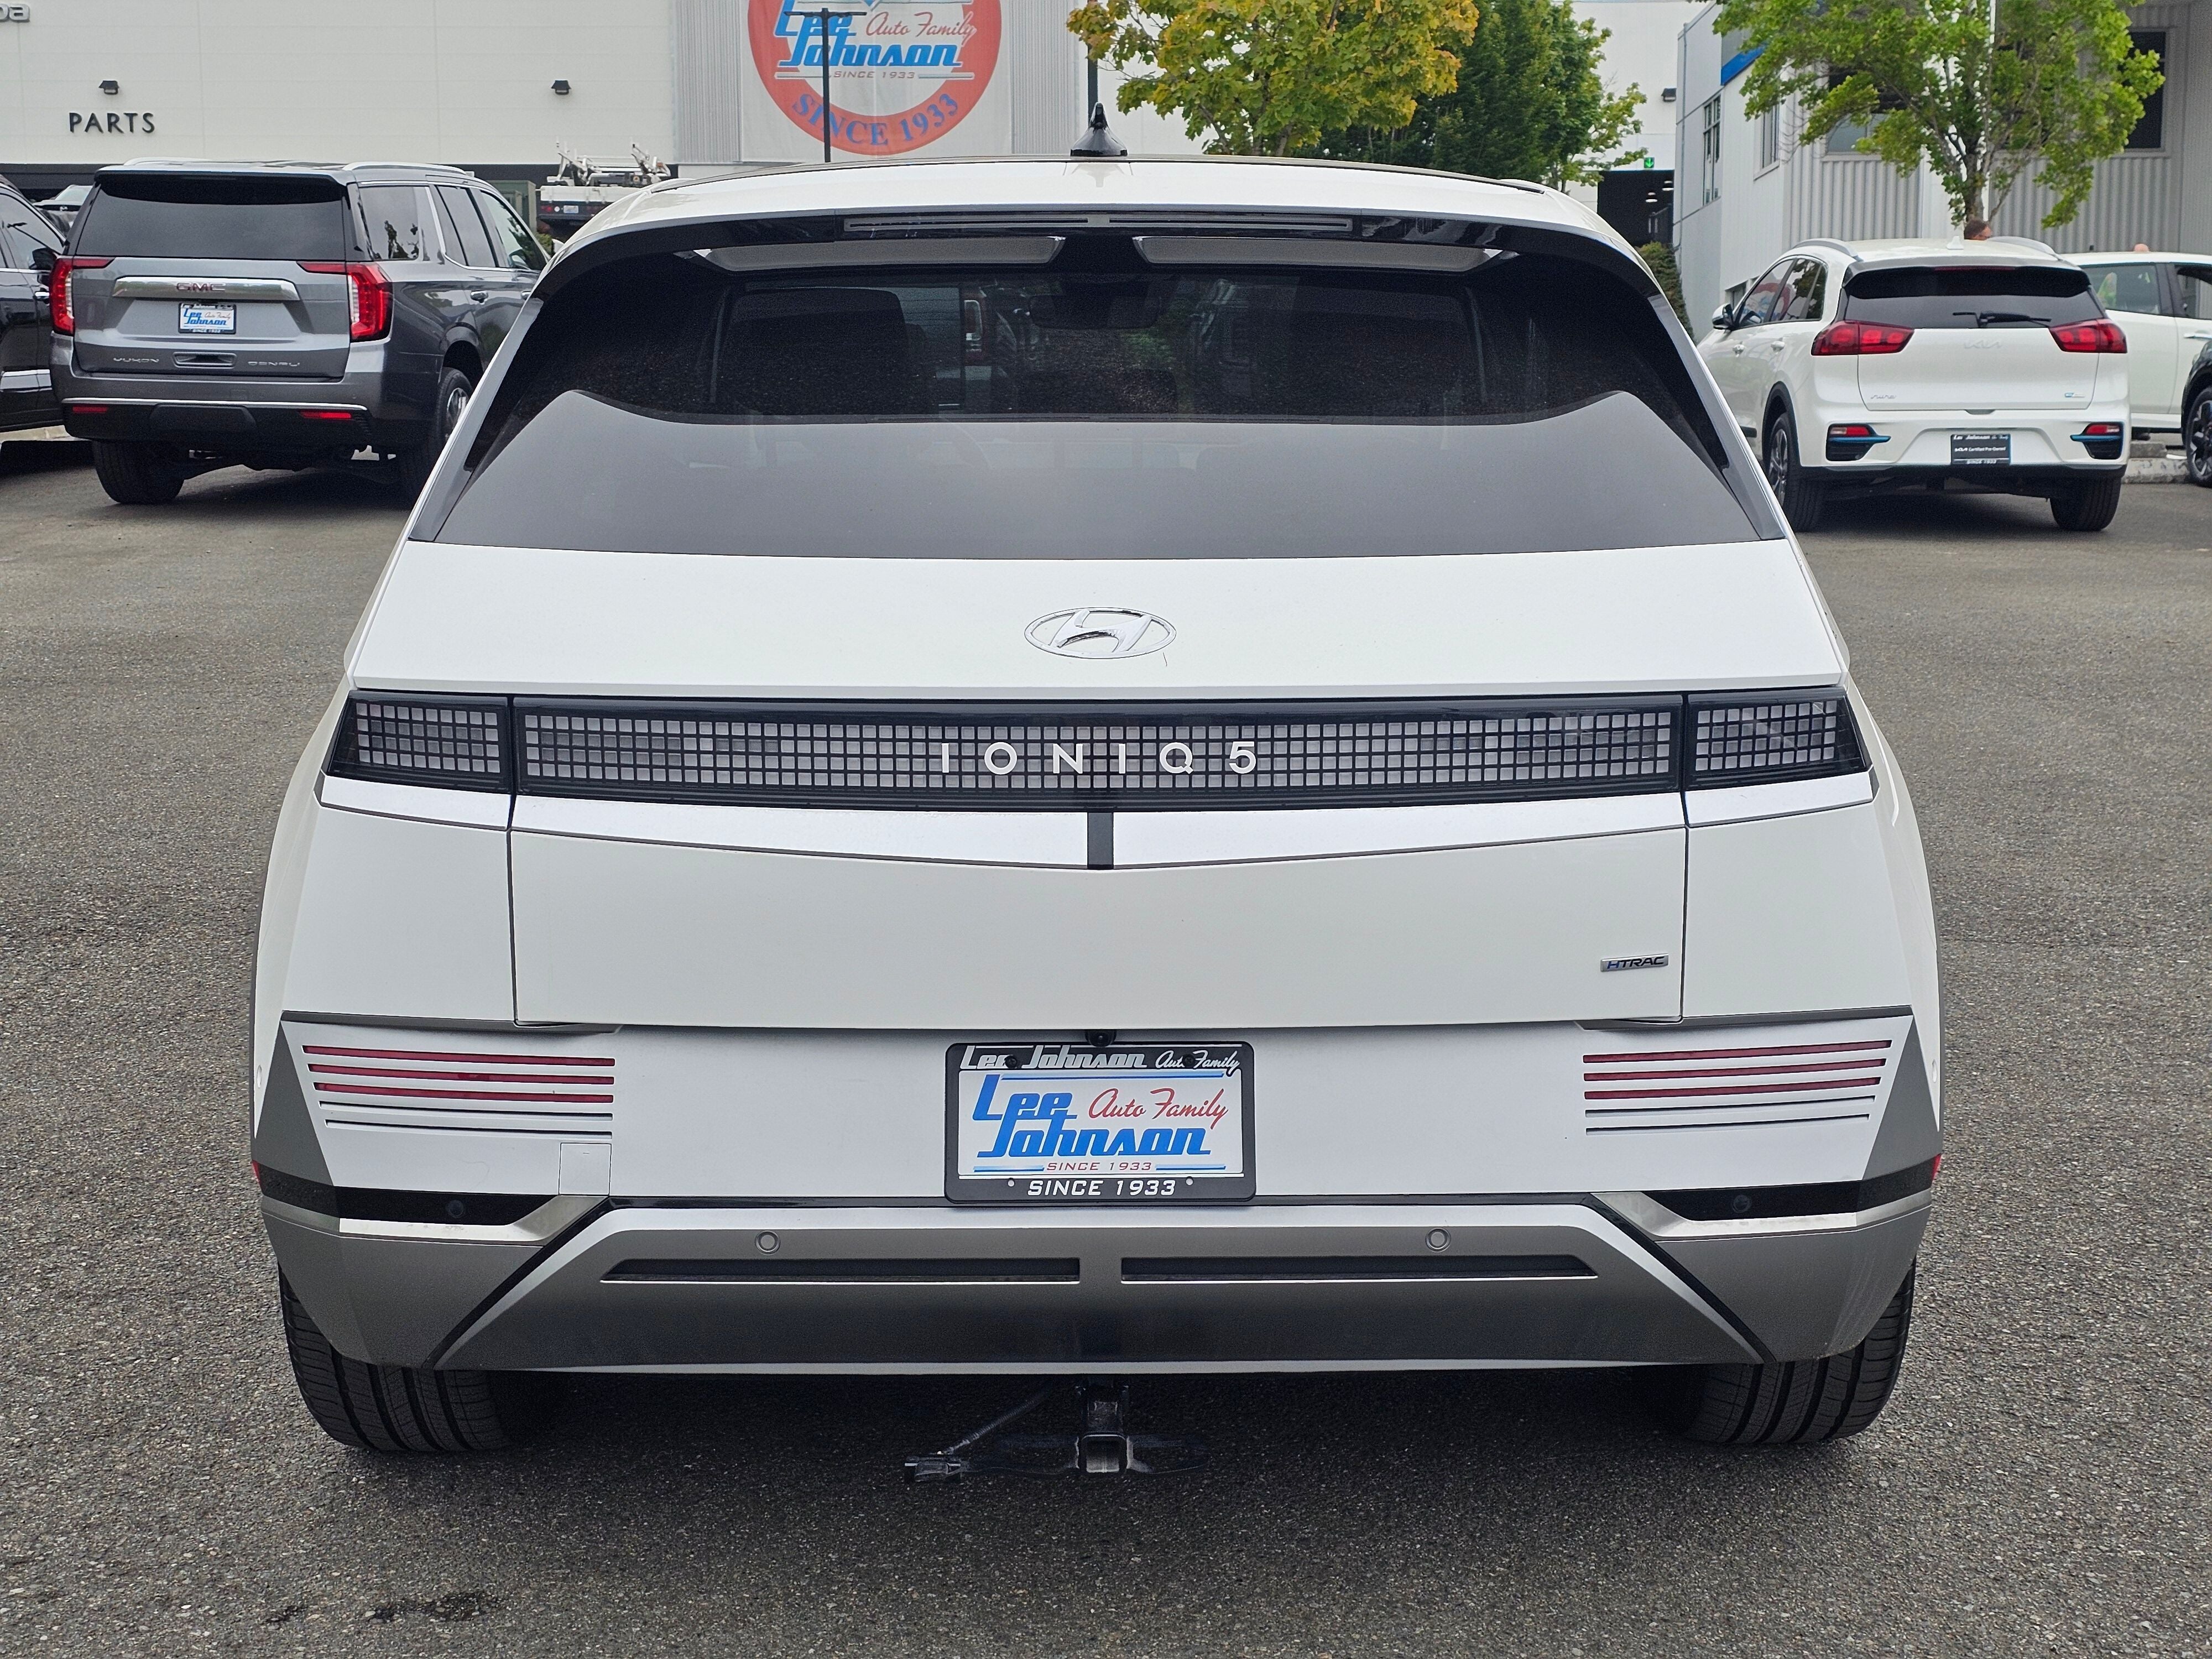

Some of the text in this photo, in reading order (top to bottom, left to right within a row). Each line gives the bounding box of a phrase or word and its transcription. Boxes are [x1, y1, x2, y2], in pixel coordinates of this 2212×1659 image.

[775, 0, 976, 46] Lee Auto Family
[778, 19, 962, 66] Johnson
[833, 70, 916, 79] SINCE 1933
[69, 112, 155, 133] PARTS
[901, 93, 959, 142] 1933
[176, 282, 226, 292] GMC
[1606, 956, 1665, 969] HTRAC
[1021, 1045, 1147, 1069] Johnson
[1155, 1050, 1186, 1068] Aut
[1192, 1050, 1240, 1074] Family
[972, 1074, 1229, 1130] Lee Auto Family
[977, 1097, 1212, 1157] Johnson
[1046, 1162, 1152, 1171] SINCE 1933
[1027, 1180, 1176, 1196] SINCE 1933
